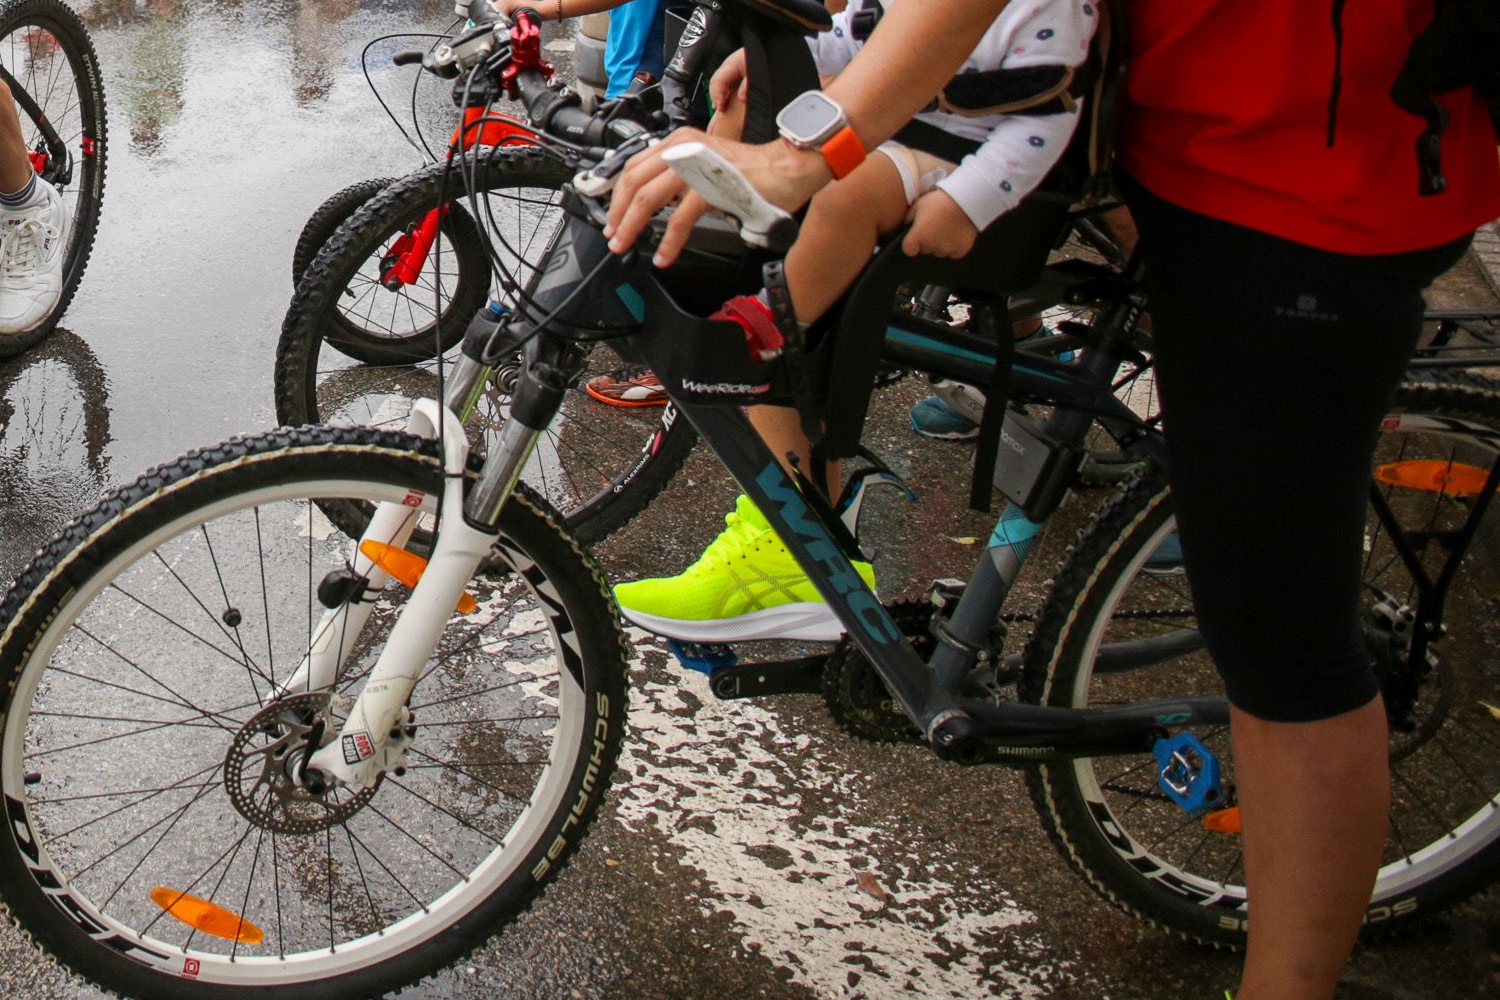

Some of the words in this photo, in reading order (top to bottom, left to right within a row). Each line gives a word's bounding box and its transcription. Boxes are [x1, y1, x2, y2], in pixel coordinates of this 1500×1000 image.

[755, 460, 900, 645] WRC
[354, 735, 373, 759] ROCK
[532, 691, 610, 882] SCHWALBE
